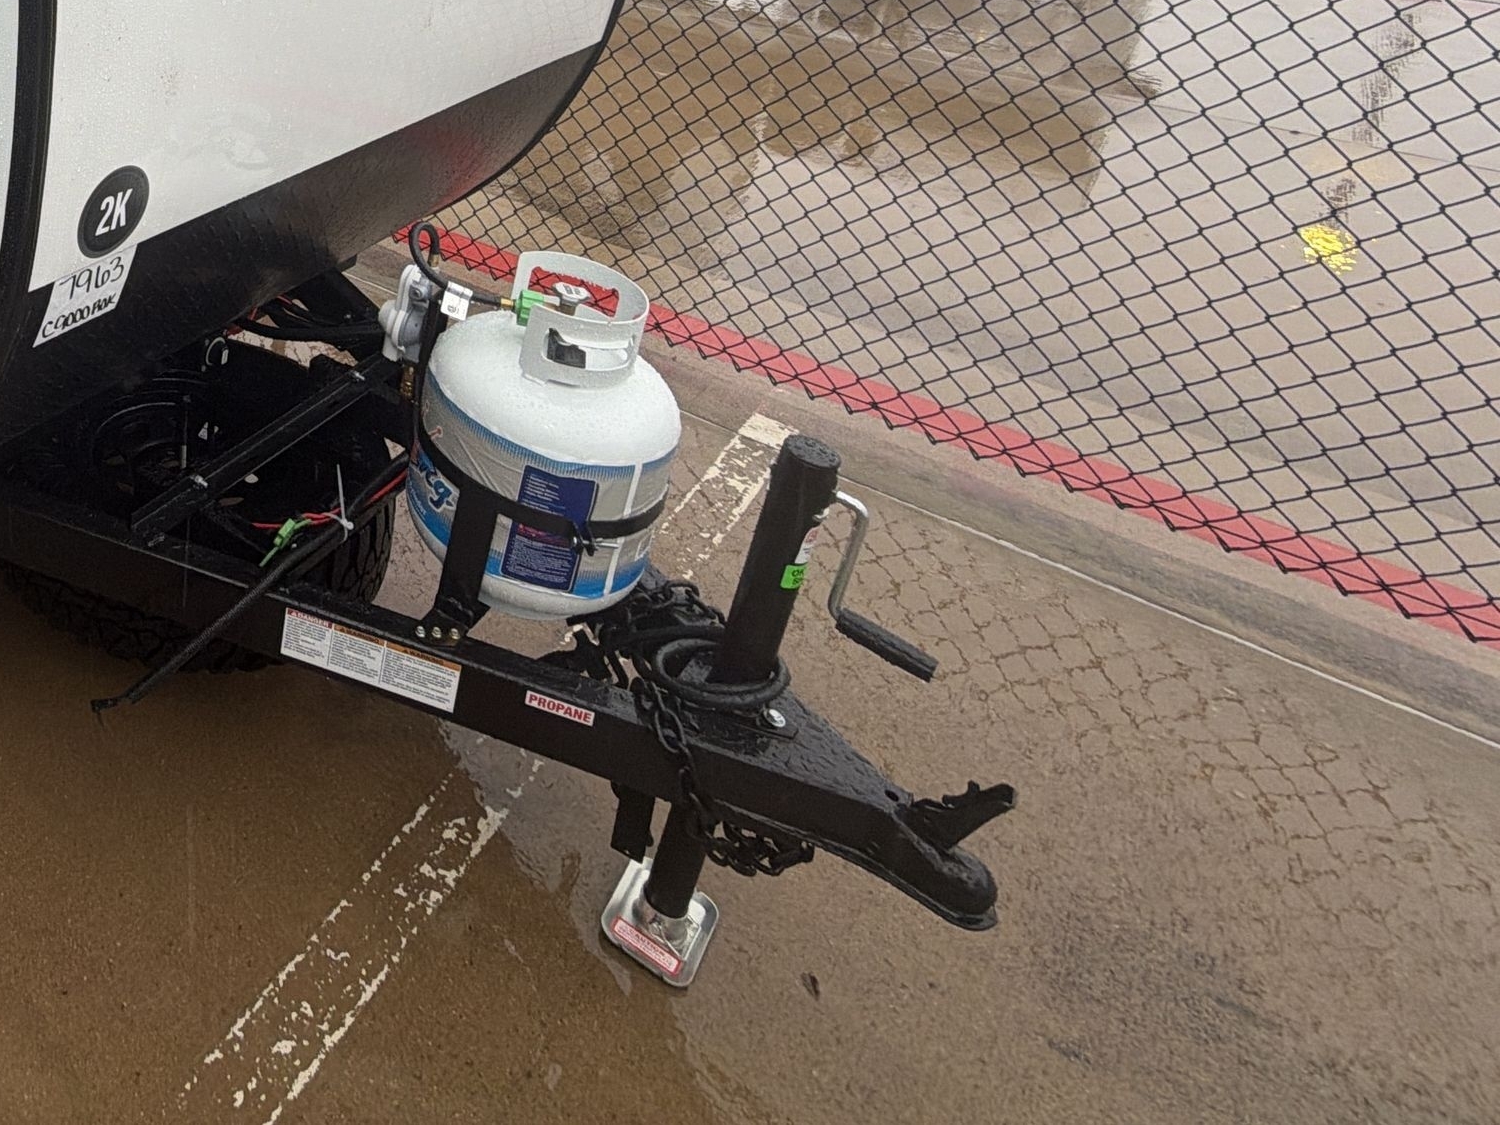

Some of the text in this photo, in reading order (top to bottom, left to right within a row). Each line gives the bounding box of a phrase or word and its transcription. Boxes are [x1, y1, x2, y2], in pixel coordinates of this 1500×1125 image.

[94, 188, 134, 237] 2K
[59, 256, 125, 300] 7963
[528, 693, 592, 724] PROPANE
